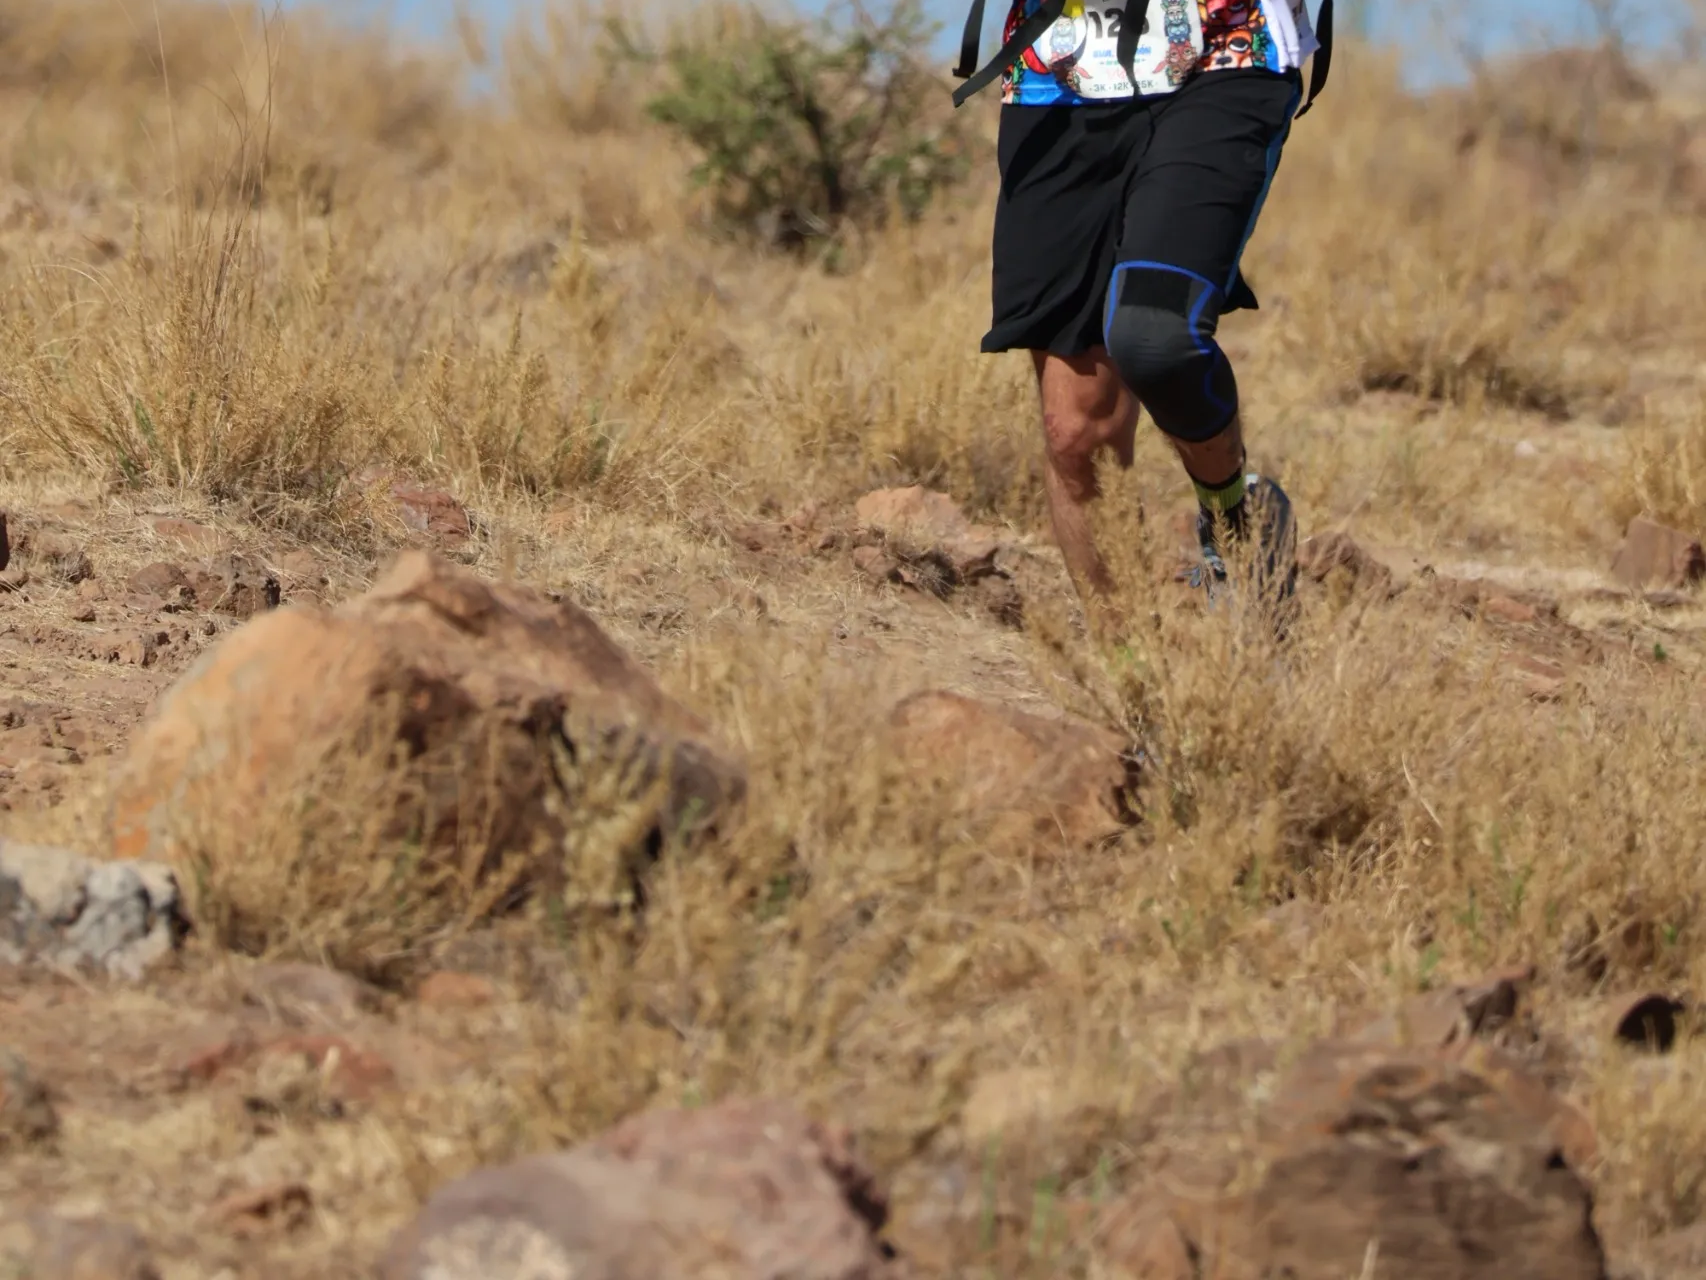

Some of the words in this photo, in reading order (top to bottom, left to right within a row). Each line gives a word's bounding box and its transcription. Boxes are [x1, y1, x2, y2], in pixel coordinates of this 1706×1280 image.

[1087, 8, 1150, 39] 12
[1093, 83, 1106, 92] 3K
[1113, 82, 1129, 91] 12K
